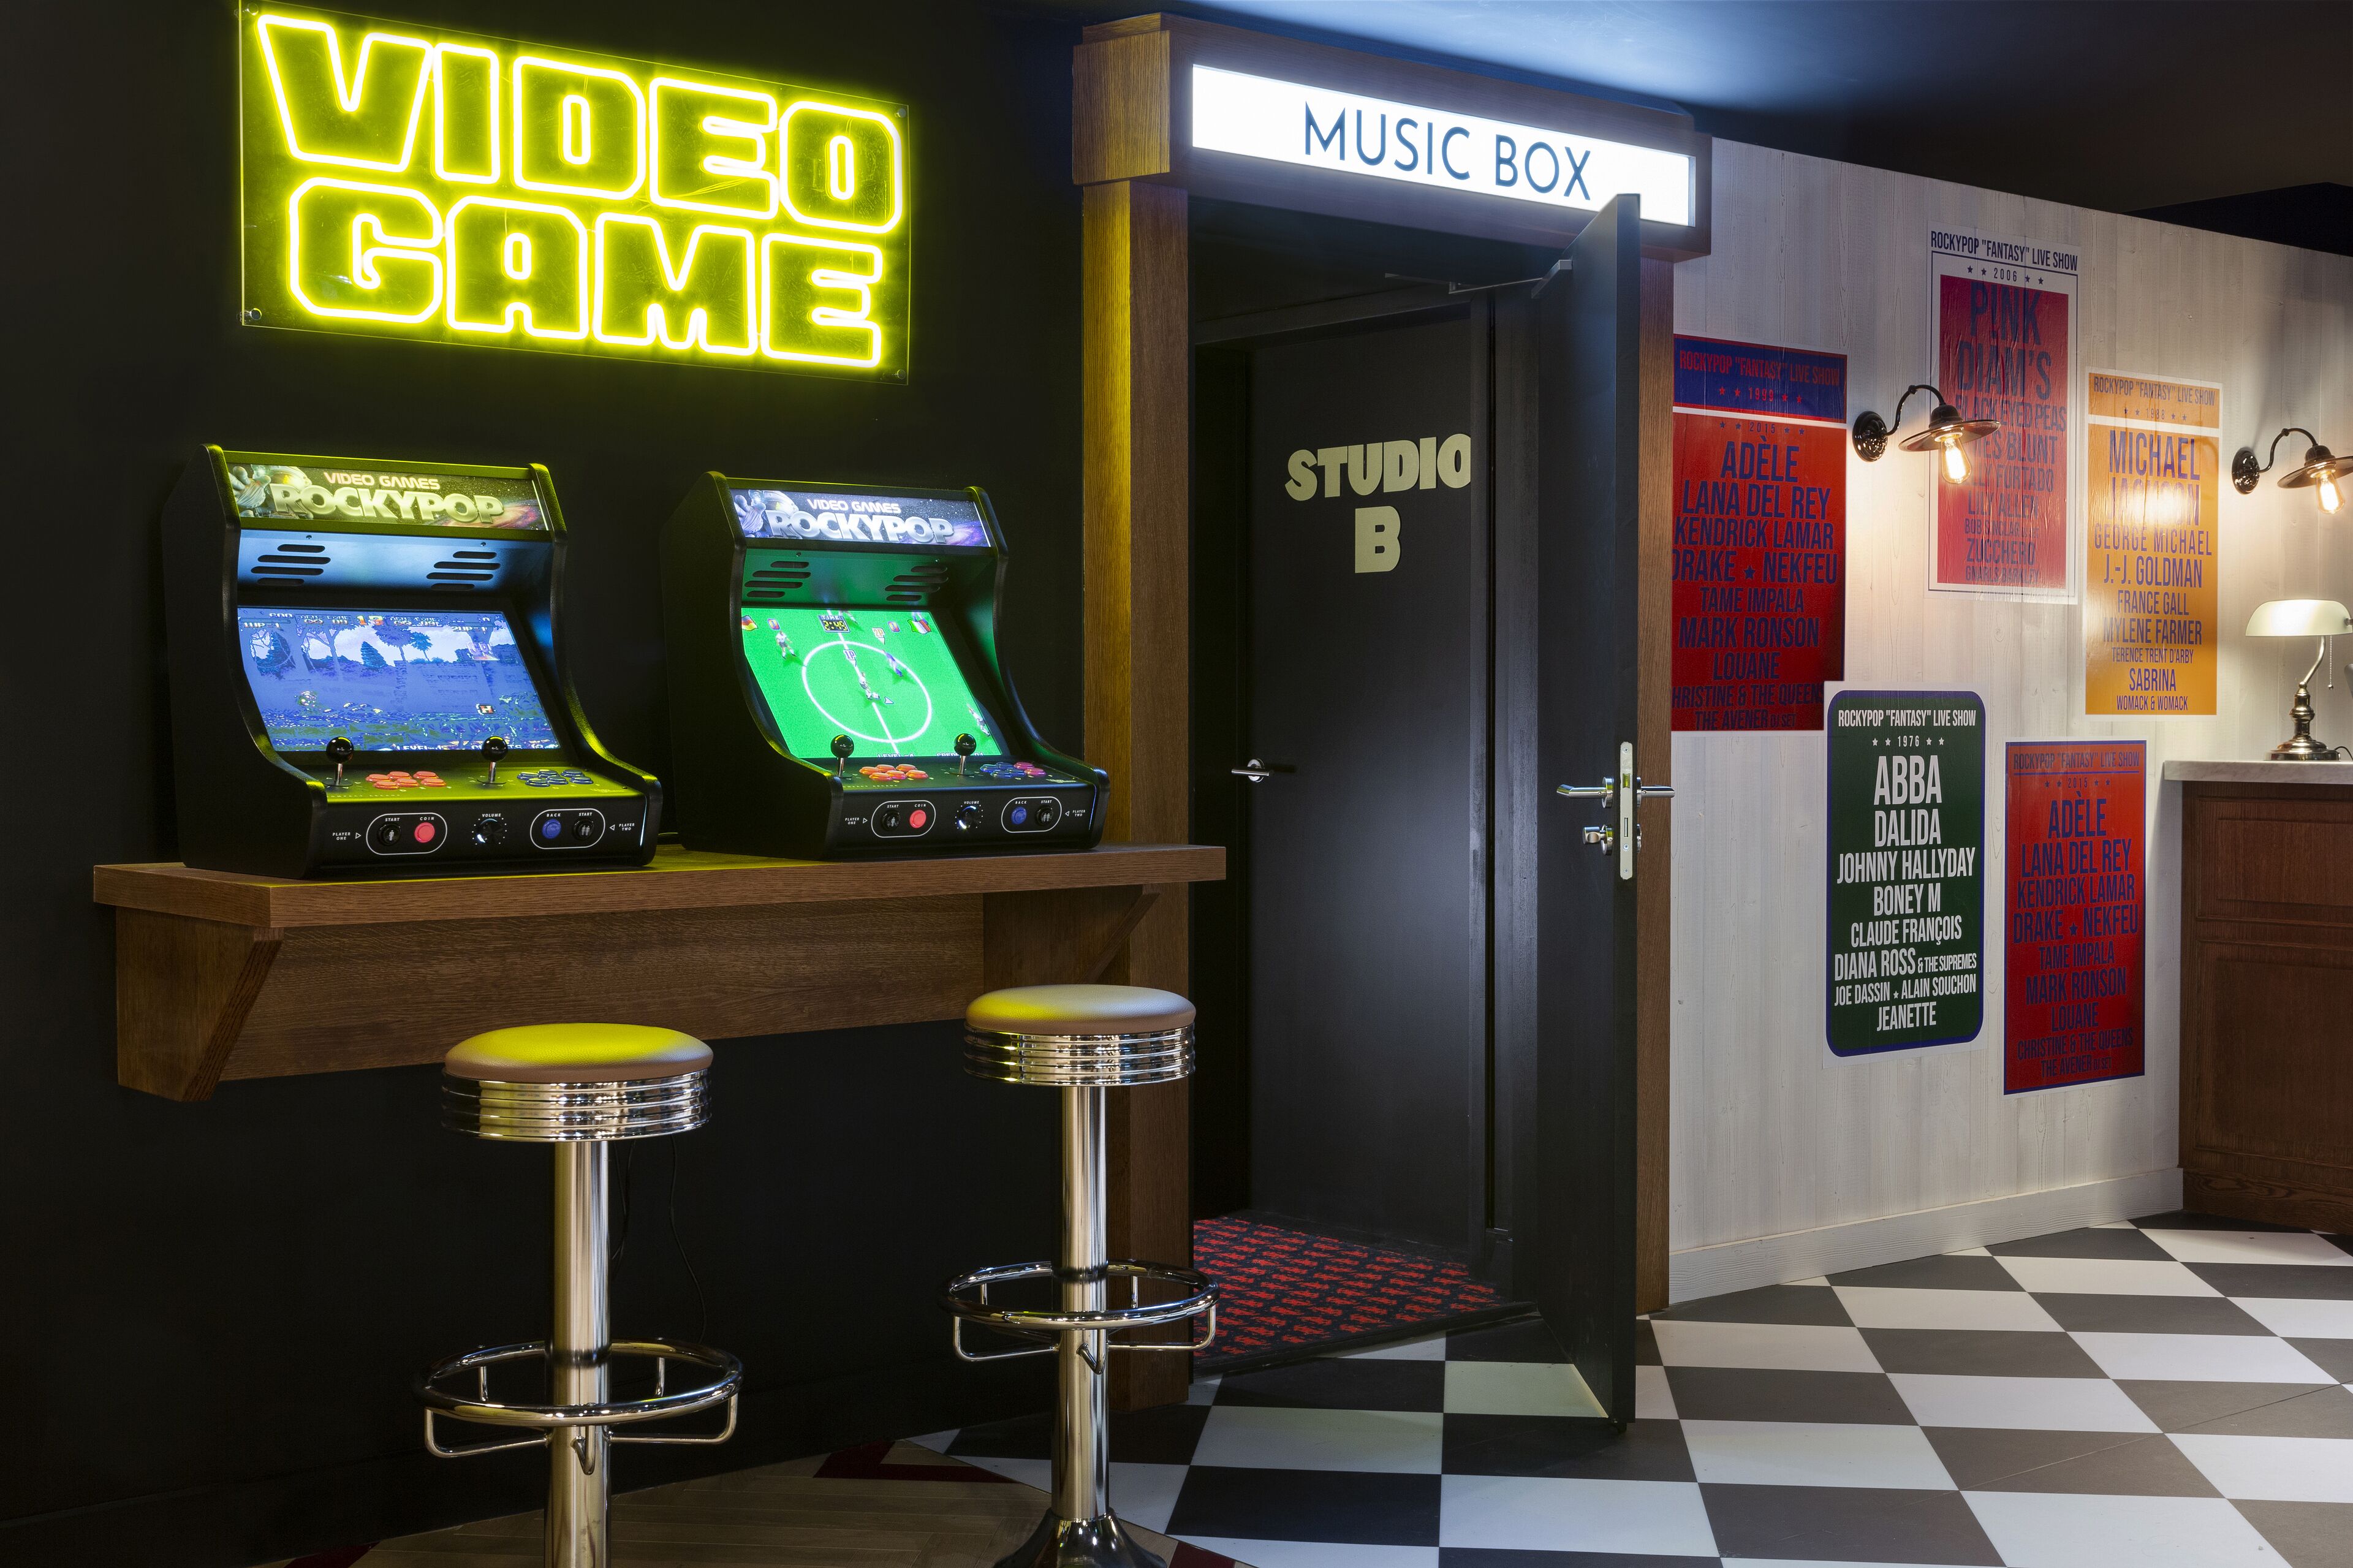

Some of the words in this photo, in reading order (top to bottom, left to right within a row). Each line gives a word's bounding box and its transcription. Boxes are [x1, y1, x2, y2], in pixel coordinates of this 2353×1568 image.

[257, 13, 904, 234] VIDEO
[1305, 100, 1471, 180] MUSIC
[1495, 134, 1591, 200] BOX
[1931, 230, 1979, 254] ROCKYPOP
[1982, 239, 2029, 262] "FANTASY"
[2032, 248, 2050, 267] LIVE
[2053, 251, 2078, 271] SHOW
[287, 176, 884, 368] GAME
[1994, 267, 2017, 282] 2006
[1969, 281, 2042, 346] P!NK
[1680, 350, 1732, 375] ROCKYPOP
[1735, 357, 1787, 380] "FANTASY"
[1789, 363, 1810, 383] LIVE
[1812, 366, 1840, 387] SHOW
[1958, 340, 2052, 400] DIAM'S
[1749, 387, 1774, 402] 1999
[2094, 376, 2134, 396] ROCKYPOP
[2136, 381, 2175, 401] "FANTASY"
[2177, 387, 2194, 403] LIVE
[2195, 388, 2216, 406] SHOW
[1749, 422, 1776, 435] 2015
[2000, 399, 2033, 428] EYED
[2035, 403, 2067, 432] PEAS
[1720, 435, 1800, 483] ADÈLE
[2007, 431, 2058, 464] BLUNT
[2110, 430, 2200, 481] MICHAEL
[324, 472, 375, 486] VIDEO
[379, 476, 441, 490] GAMES
[1285, 433, 1471, 501] STUDIO
[1996, 464, 2054, 493] FURTADO
[270, 483, 504, 524] ROCKYPOP
[806, 499, 849, 511] VIDEO
[852, 502, 902, 513] GAMES
[1682, 479, 1740, 517] LANA
[1747, 483, 1785, 518] DEL
[1791, 486, 1832, 520] REY
[1968, 490, 1995, 516] LILY
[1998, 493, 2039, 520] ALLEN
[765, 509, 955, 544] ROCKYPOP
[1355, 506, 1401, 574] B
[1675, 517, 1767, 548] KENDRICK
[1773, 521, 1834, 550] LAMAR
[1964, 518, 1982, 535] BOB
[2094, 522, 2148, 551] GEORGE
[2154, 528, 2212, 556] MICHAEL
[1763, 551, 1838, 585] NEKFEU
[1966, 537, 2036, 566] ZUCCHERO
[2136, 555, 2202, 588] GOLDMAN
[1699, 587, 1744, 612] TAME
[1747, 588, 1805, 613] IMPALA
[2118, 589, 2159, 615] FRANCE
[2163, 592, 2189, 616] GALL
[1678, 617, 1738, 648] MARK
[1743, 617, 1820, 648] RONSON
[2103, 616, 2152, 643] MYLENE
[2156, 619, 2202, 645] FARMER
[1712, 651, 1781, 681] LOUANE
[2112, 646, 2143, 663] TERENCE
[2145, 648, 2169, 663] TRENT
[2169, 648, 2194, 664] D'ARBY
[1672, 685, 1736, 709] HRISTINE
[1738, 684, 1746, 707] &
[1751, 683, 1776, 706] THE
[2129, 668, 2177, 692] SABRINA
[1838, 710, 1884, 727] ROCKYPOP
[1886, 710, 1932, 726] "FANTASY"
[1933, 710, 1951, 726] LIVE
[1952, 710, 1976, 726] SHOW
[2116, 695, 2148, 711] WOMACK
[2150, 695, 2155, 710] &
[2157, 695, 2188, 711] WOMACK
[1695, 710, 1719, 731] THE
[1721, 709, 1768, 730] AVENER
[1897, 735, 1920, 747] 1976
[2014, 753, 2055, 770] ROCKYPOP
[2057, 752, 2098, 768] "FANTASY"
[2101, 752, 2116, 767] LIVE
[2118, 751, 2140, 767] SHOW
[1873, 755, 1942, 805] ABBA
[2067, 777, 2088, 789] 2015
[1874, 808, 1941, 847] DALIDA
[2048, 790, 2107, 839] ADÈLE
[1837, 850, 1898, 884] JOHNNY
[1902, 847, 1976, 880] HALLYDAY
[2021, 842, 2064, 877] LANA
[2069, 840, 2097, 874] DEL
[2102, 838, 2132, 873] REY
[1874, 884, 1924, 916] BONEY
[1928, 882, 1941, 912] M
[2017, 877, 2085, 909] KENDRICK
[2090, 874, 2135, 903] LAMAR
[1851, 920, 1900, 947] CLAUDE
[1903, 915, 1962, 945] FRANÇOIS
[2014, 909, 2064, 944] DRAKE
[2083, 904, 2138, 937] NEKFEU
[1835, 951, 1877, 980] DIANA
[1881, 947, 1916, 977] ROSS
[1917, 957, 1923, 973] &
[1924, 956, 1938, 973] THE
[1939, 953, 1977, 972] SUPREMES
[2039, 944, 2069, 970] TAME
[2073, 941, 2114, 967] IMPALA
[1834, 985, 1852, 1006] JOE
[1855, 982, 1890, 1004] DASSIN
[1901, 978, 1930, 999] ALAIN
[1932, 974, 1976, 996] SOUCHON
[2026, 972, 2067, 1006] MARK
[2071, 966, 2126, 1001] RONSON
[1876, 1001, 1936, 1031] JEANETTE
[2052, 1002, 2099, 1032] LOUANE
[2017, 1035, 2067, 1061] CHRISTINE
[2070, 1034, 2077, 1053] &
[2078, 1031, 2096, 1052] THE
[2098, 1027, 2134, 1050] QUEENS
[2040, 1059, 2057, 1078] THE
[2059, 1055, 2091, 1074] AVENER
[2101, 1057, 2112, 1070] SET
